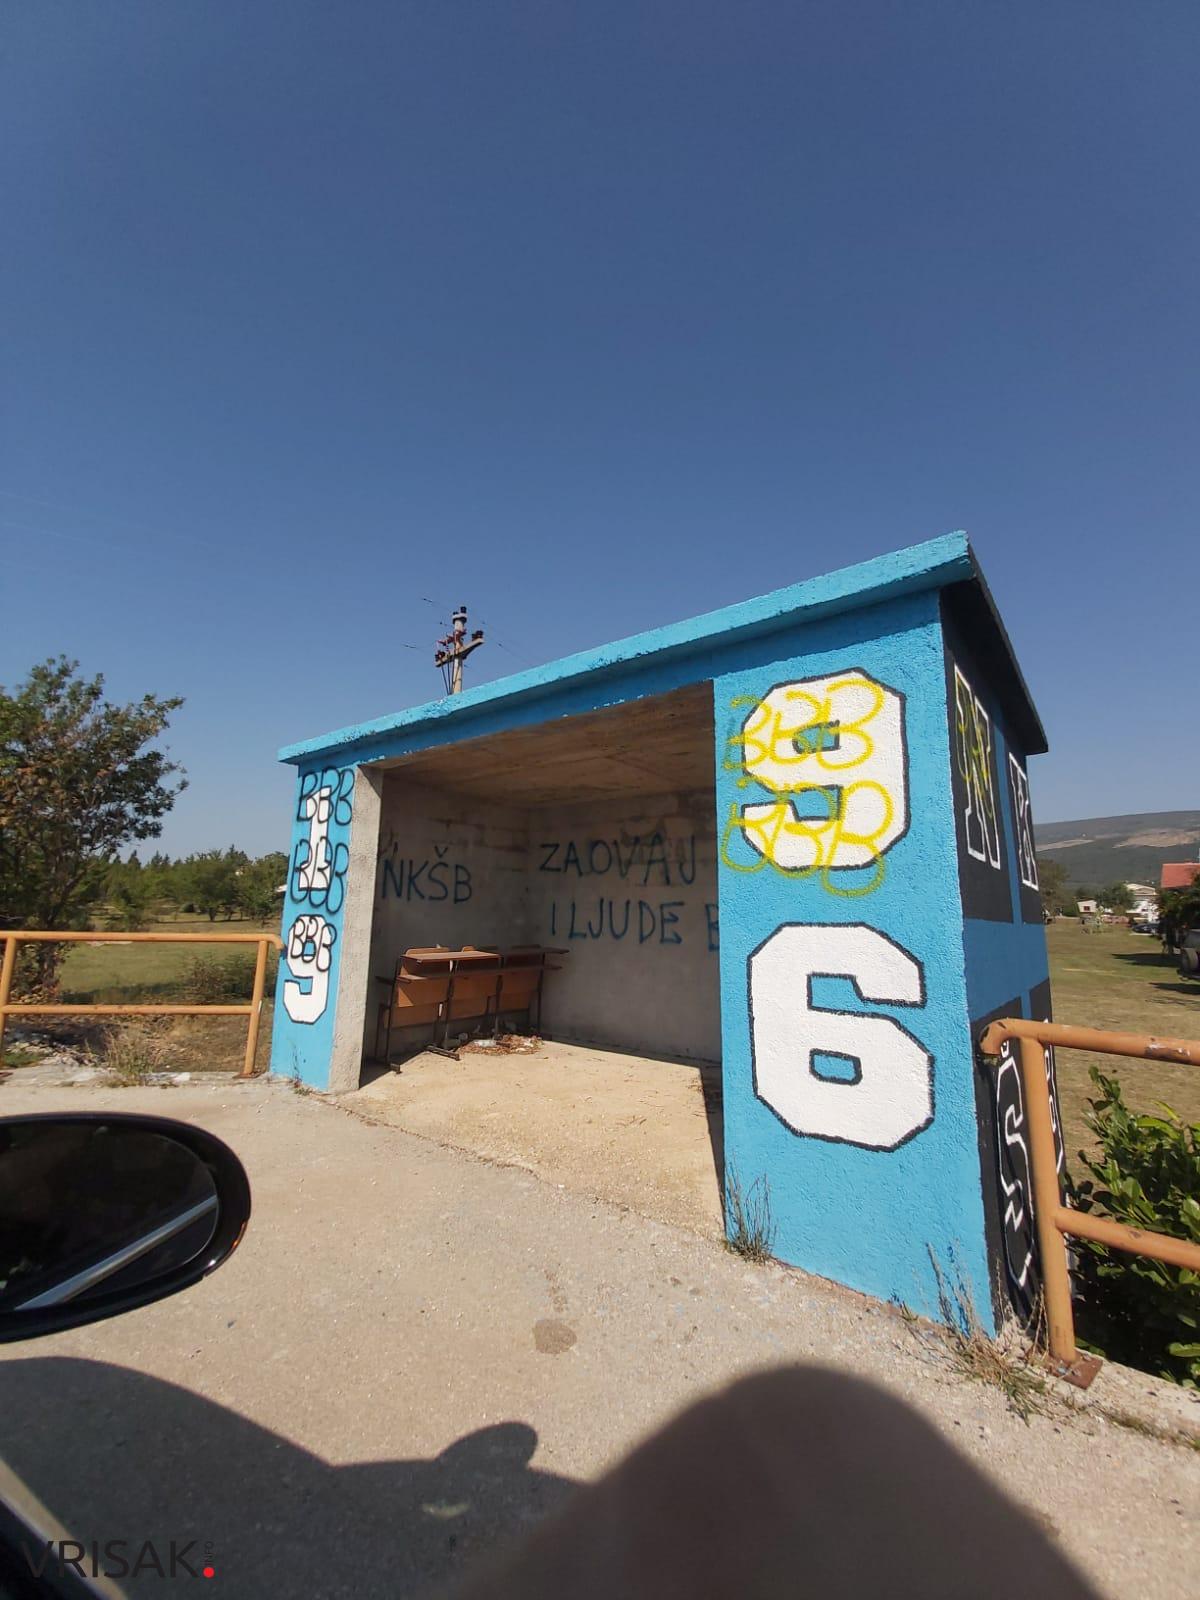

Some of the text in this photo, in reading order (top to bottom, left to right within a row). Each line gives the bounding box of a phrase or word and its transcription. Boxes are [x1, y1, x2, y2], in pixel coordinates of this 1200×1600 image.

[381, 844, 473, 905] NKŠB
[568, 898, 686, 944] LJUDE
[747, 921, 936, 1153] 6
